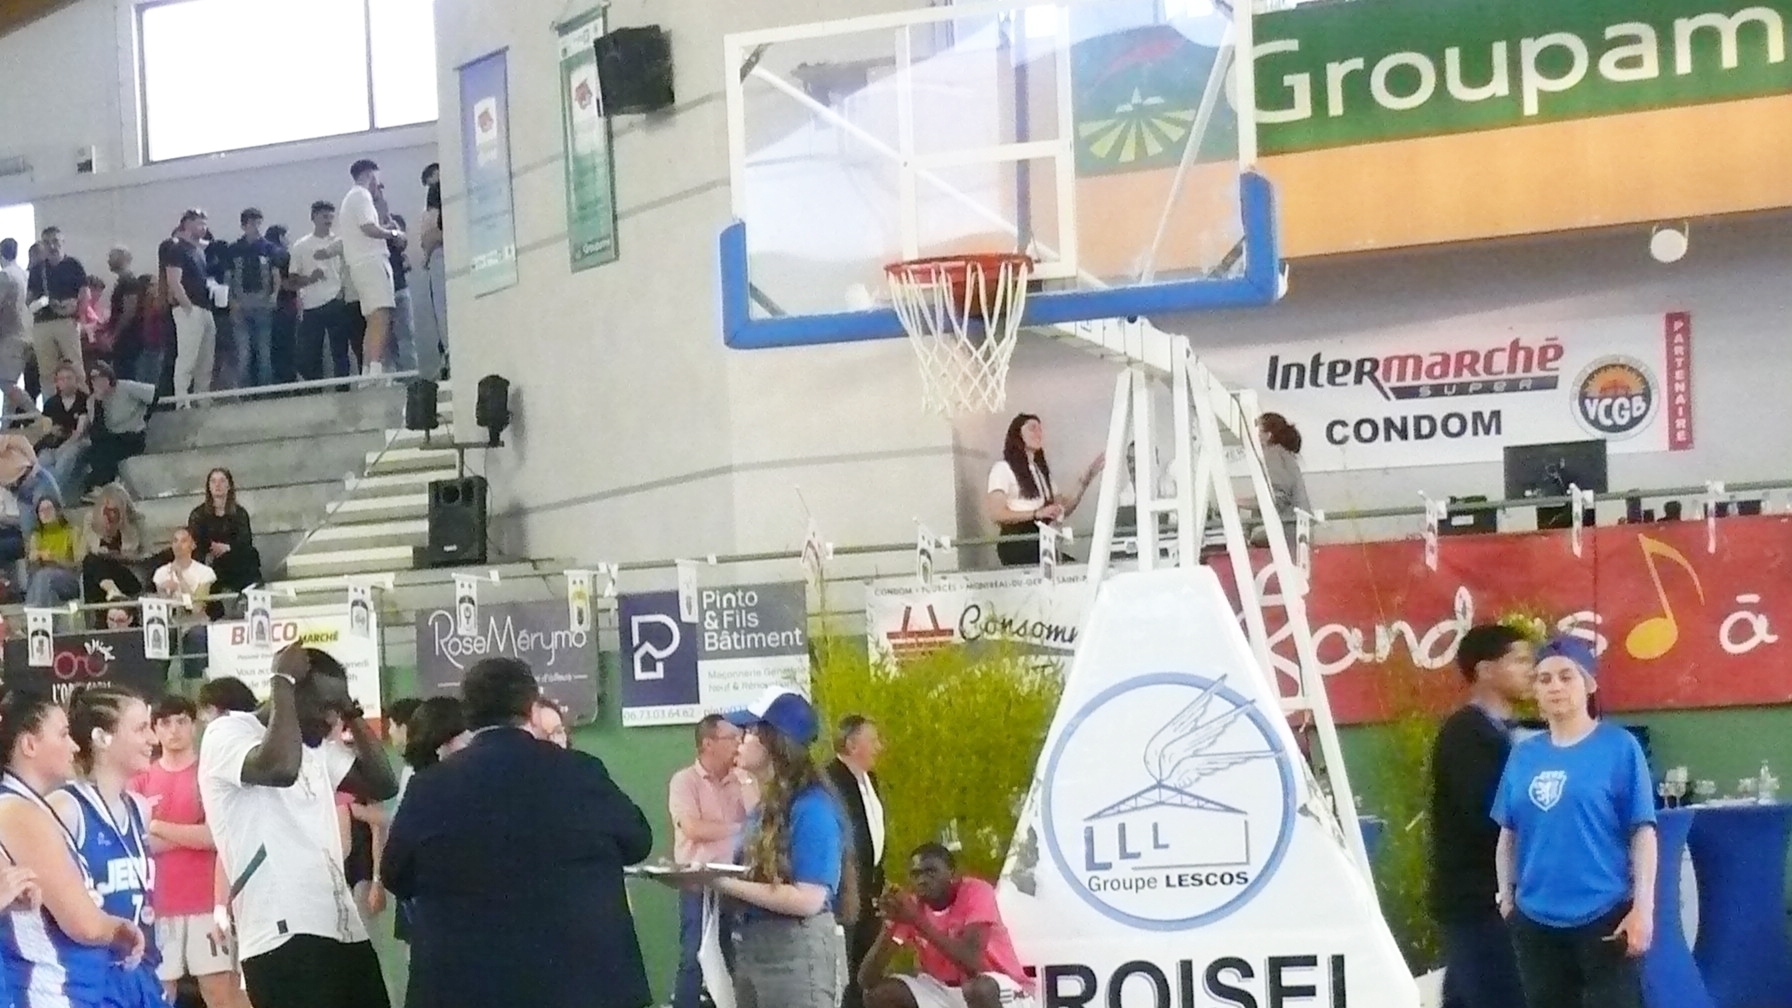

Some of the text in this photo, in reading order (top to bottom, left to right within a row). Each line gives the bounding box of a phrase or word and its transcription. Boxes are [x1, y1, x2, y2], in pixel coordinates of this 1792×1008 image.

[1416, 377, 1535, 400] SUPER
[1672, 319, 1687, 442] PARTENAIRE
[1583, 395, 1648, 427] VCGB
[1326, 410, 1502, 445] CONDOM
[702, 590, 758, 610] Pinto
[704, 609, 759, 630] & Fils
[231, 622, 298, 646] BCO
[704, 627, 804, 652] Bâtiment
[1087, 871, 1249, 895] Groupe LESCOS
